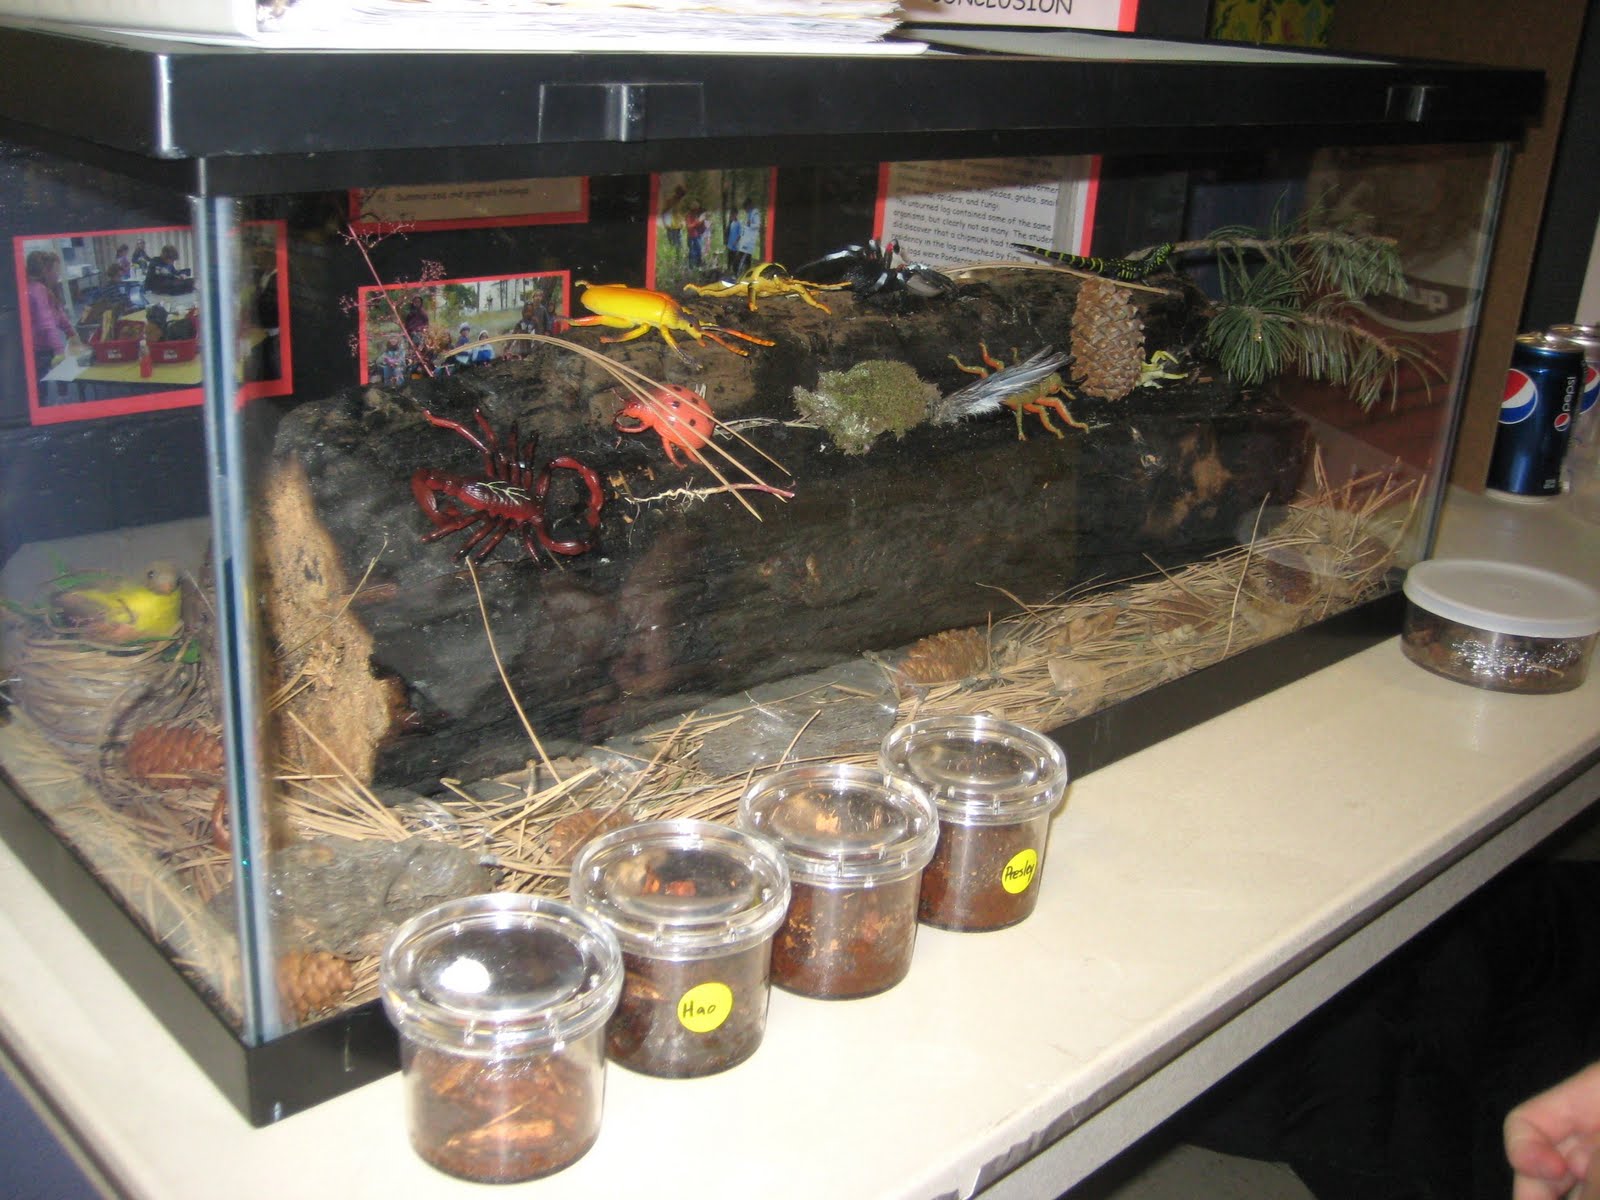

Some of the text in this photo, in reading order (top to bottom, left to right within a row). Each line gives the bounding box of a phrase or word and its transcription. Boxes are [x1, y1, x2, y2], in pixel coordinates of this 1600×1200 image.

[932, 0, 1073, 15] LUSION
[928, 215, 940, 224] but
[943, 218, 966, 231] clearly
[967, 223, 979, 231] not
[981, 225, 990, 233] as
[1013, 229, 1027, 240] The
[941, 204, 951, 216] log
[952, 208, 987, 220] contained
[988, 214, 1006, 223] some
[1008, 216, 1016, 225] of
[1018, 218, 1031, 228] the
[1033, 222, 1051, 232] same
[892, 220, 902, 229] did
[904, 223, 932, 234] discover
[934, 227, 949, 237] that
[957, 232, 989, 244] chipmunk
[991, 238, 1004, 248] had
[923, 251, 940, 260] were
[933, 240, 945, 249] the
[947, 243, 957, 253] log
[958, 245, 994, 258] untouched
[996, 250, 1005, 260] by
[1562, 376, 1577, 412] pepsi
[682, 1000, 716, 1018] Hao
